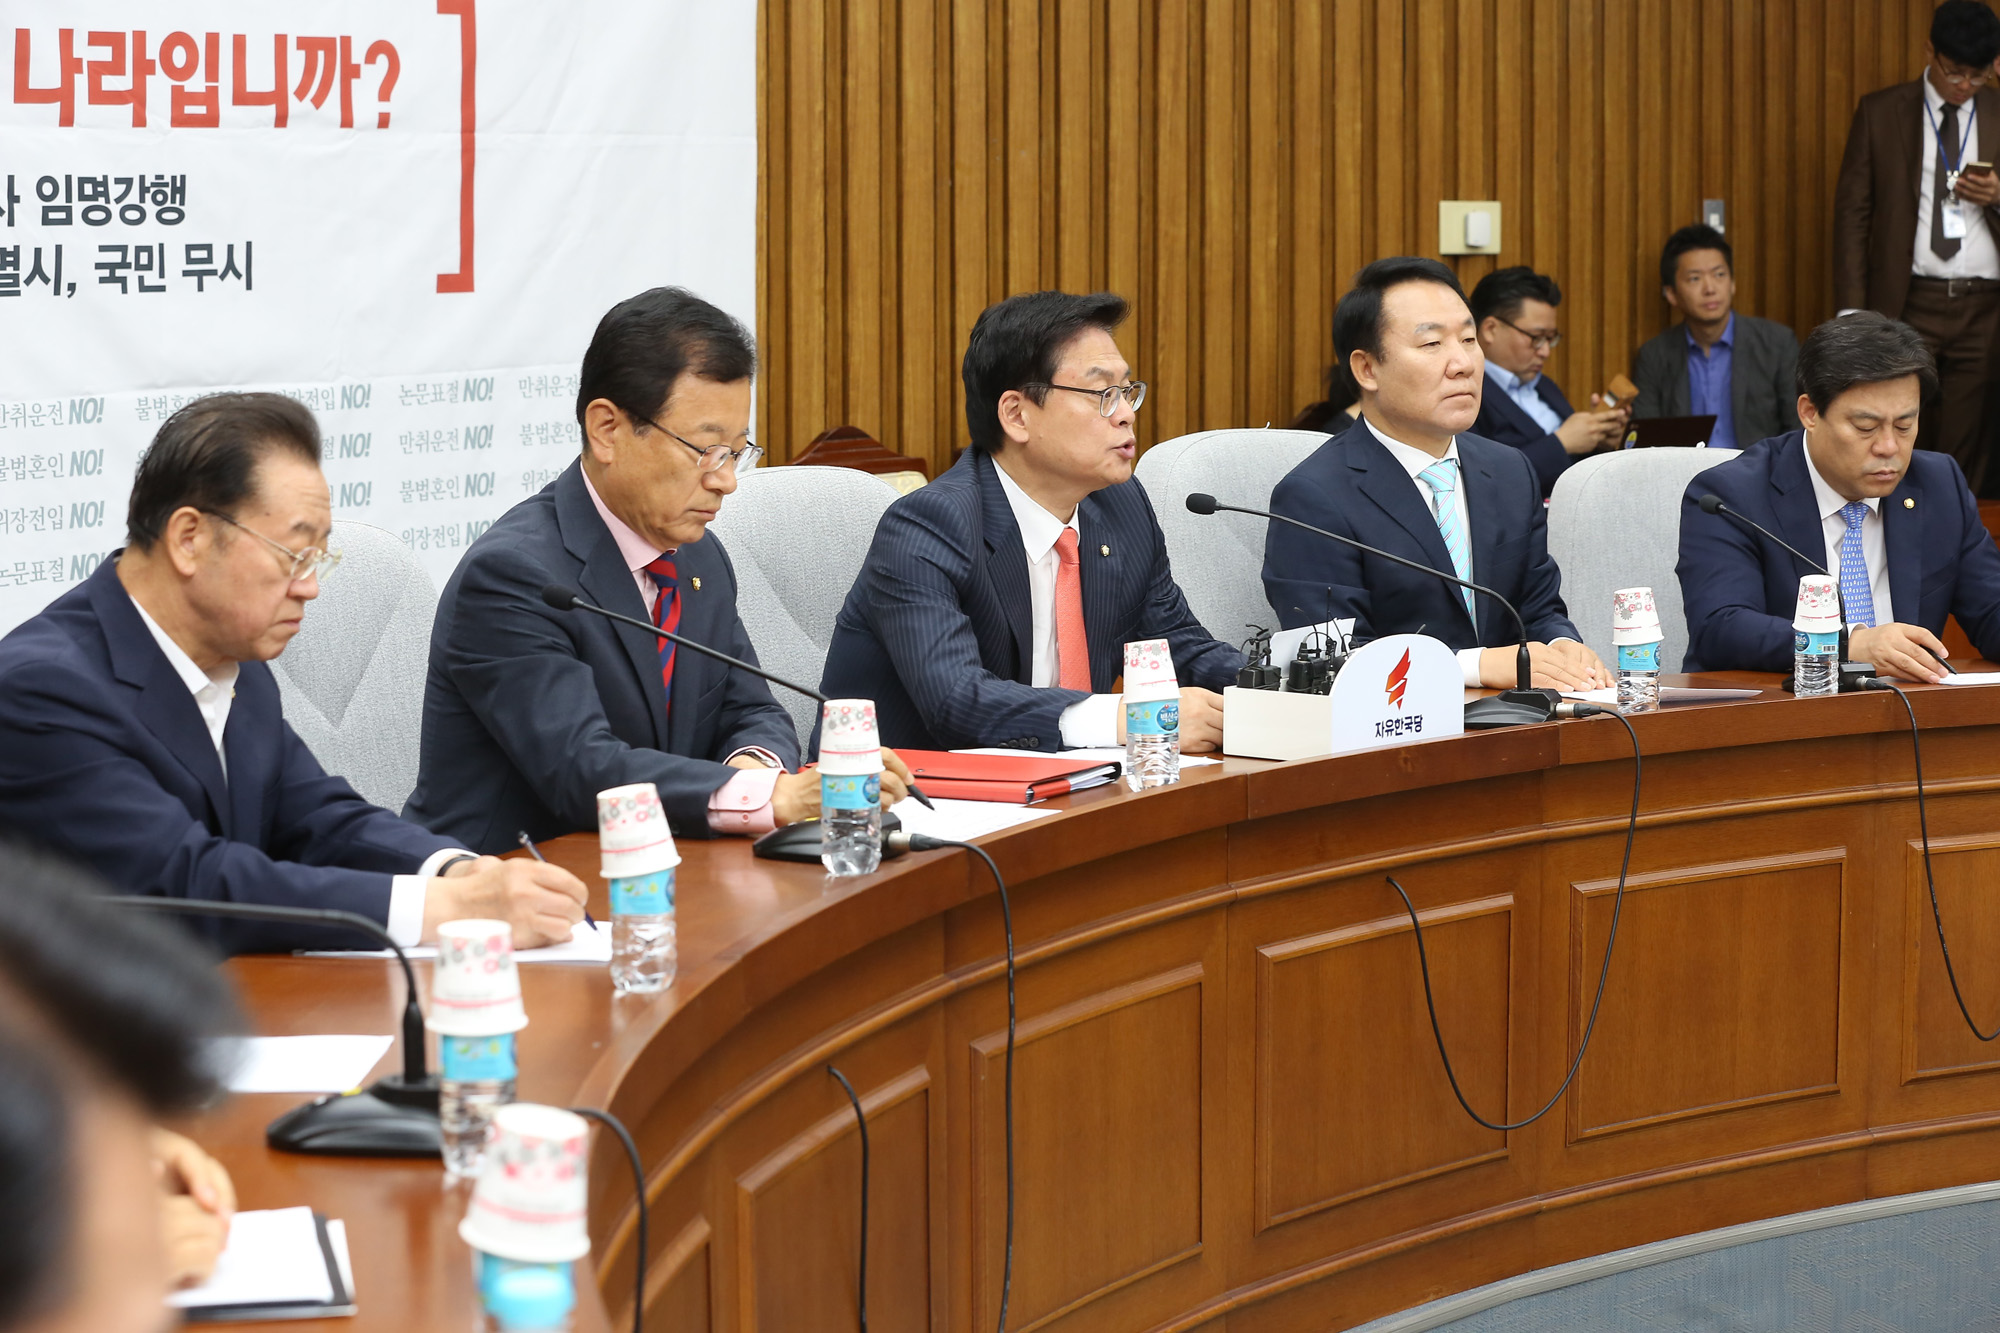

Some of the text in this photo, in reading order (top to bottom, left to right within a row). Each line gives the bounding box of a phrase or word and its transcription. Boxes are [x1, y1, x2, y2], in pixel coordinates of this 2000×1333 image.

[14, 28, 400, 128] 나라입니까?
[36, 175, 186, 226] 임명강행
[95, 243, 166, 294] 국민
[182, 241, 252, 292] 무시
[341, 384, 371, 410] NO!
[399, 377, 494, 406] 논문표절 NO!
[518, 375, 581, 399] 만취운전
[69, 397, 105, 425] NO!
[339, 433, 371, 459] NO!
[399, 424, 494, 454] 만취운전 NO!
[519, 422, 578, 446] 불법혼인
[69, 449, 104, 477] NO!
[339, 481, 372, 508] NO!
[399, 472, 495, 503] 불법혼인 NO!
[69, 500, 105, 529] NO!
[402, 523, 461, 551] 위장전입
[1375, 714, 1423, 738] 자유한국당
